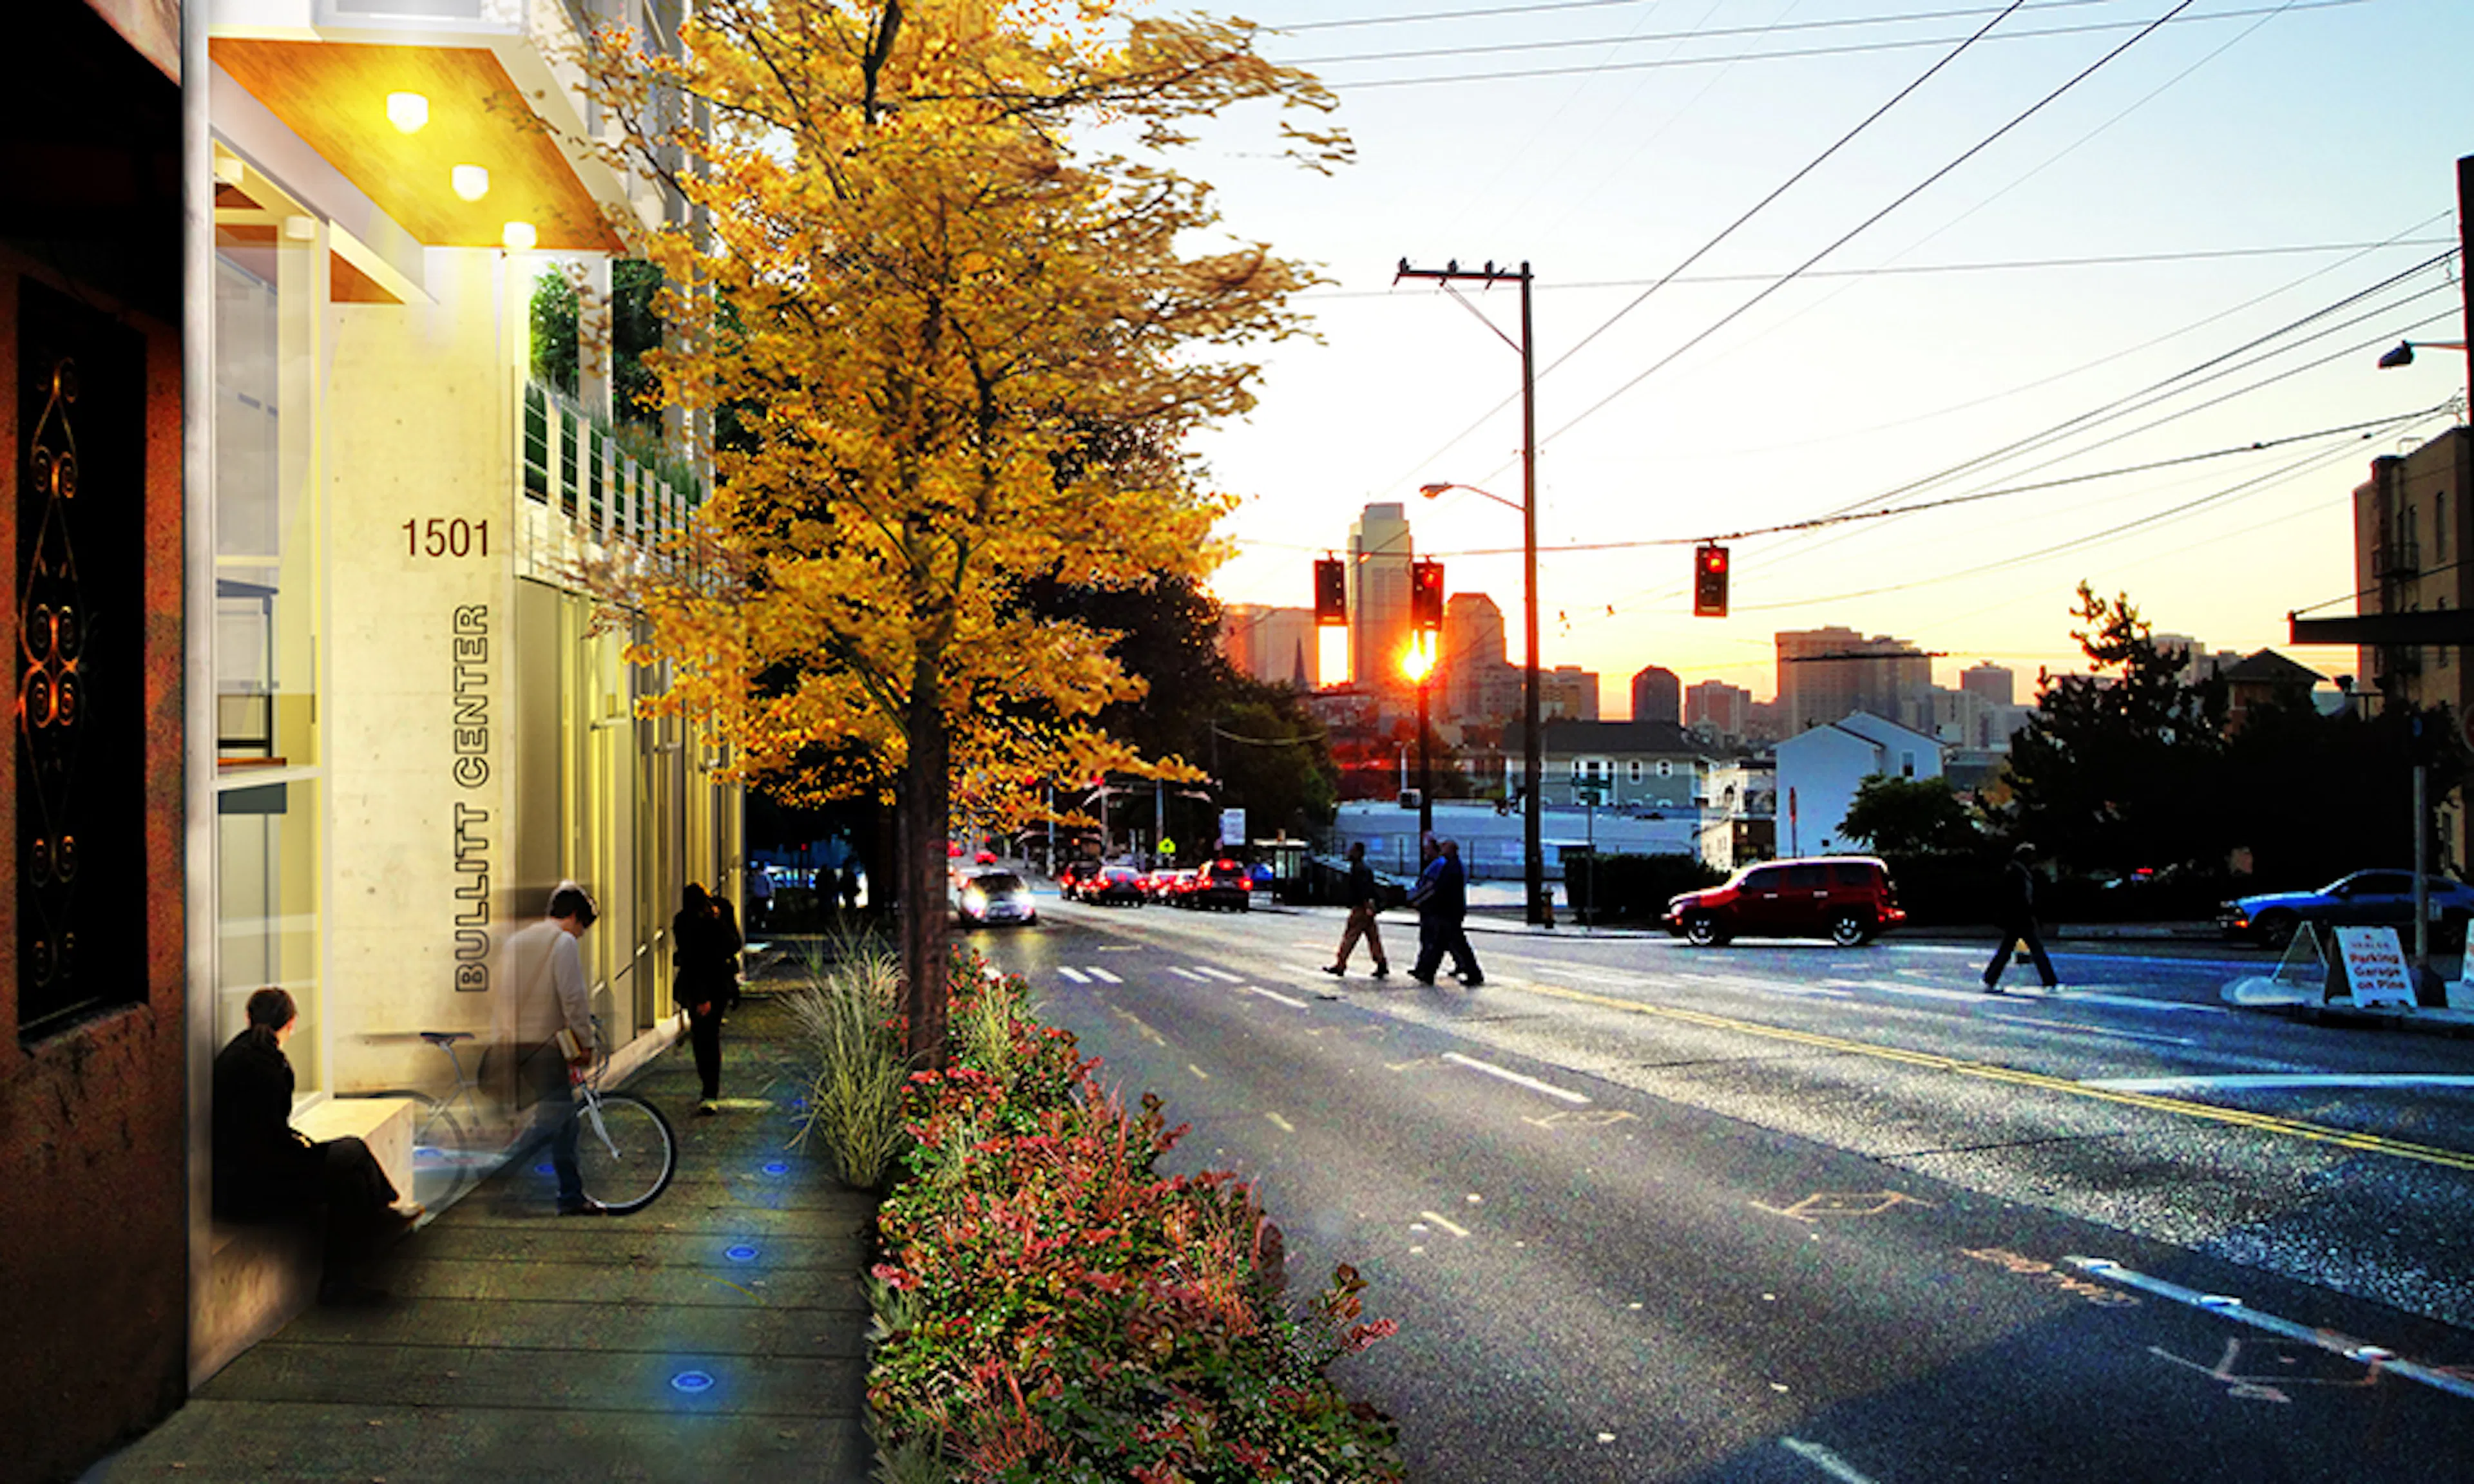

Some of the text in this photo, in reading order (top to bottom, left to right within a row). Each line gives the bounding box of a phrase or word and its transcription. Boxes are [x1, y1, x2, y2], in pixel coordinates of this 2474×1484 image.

[402, 518, 488, 557] 1501
[454, 604, 490, 993] BULLITT CENTER
[2350, 953, 2399, 965] Parking
[2354, 966, 2401, 977] Garage
